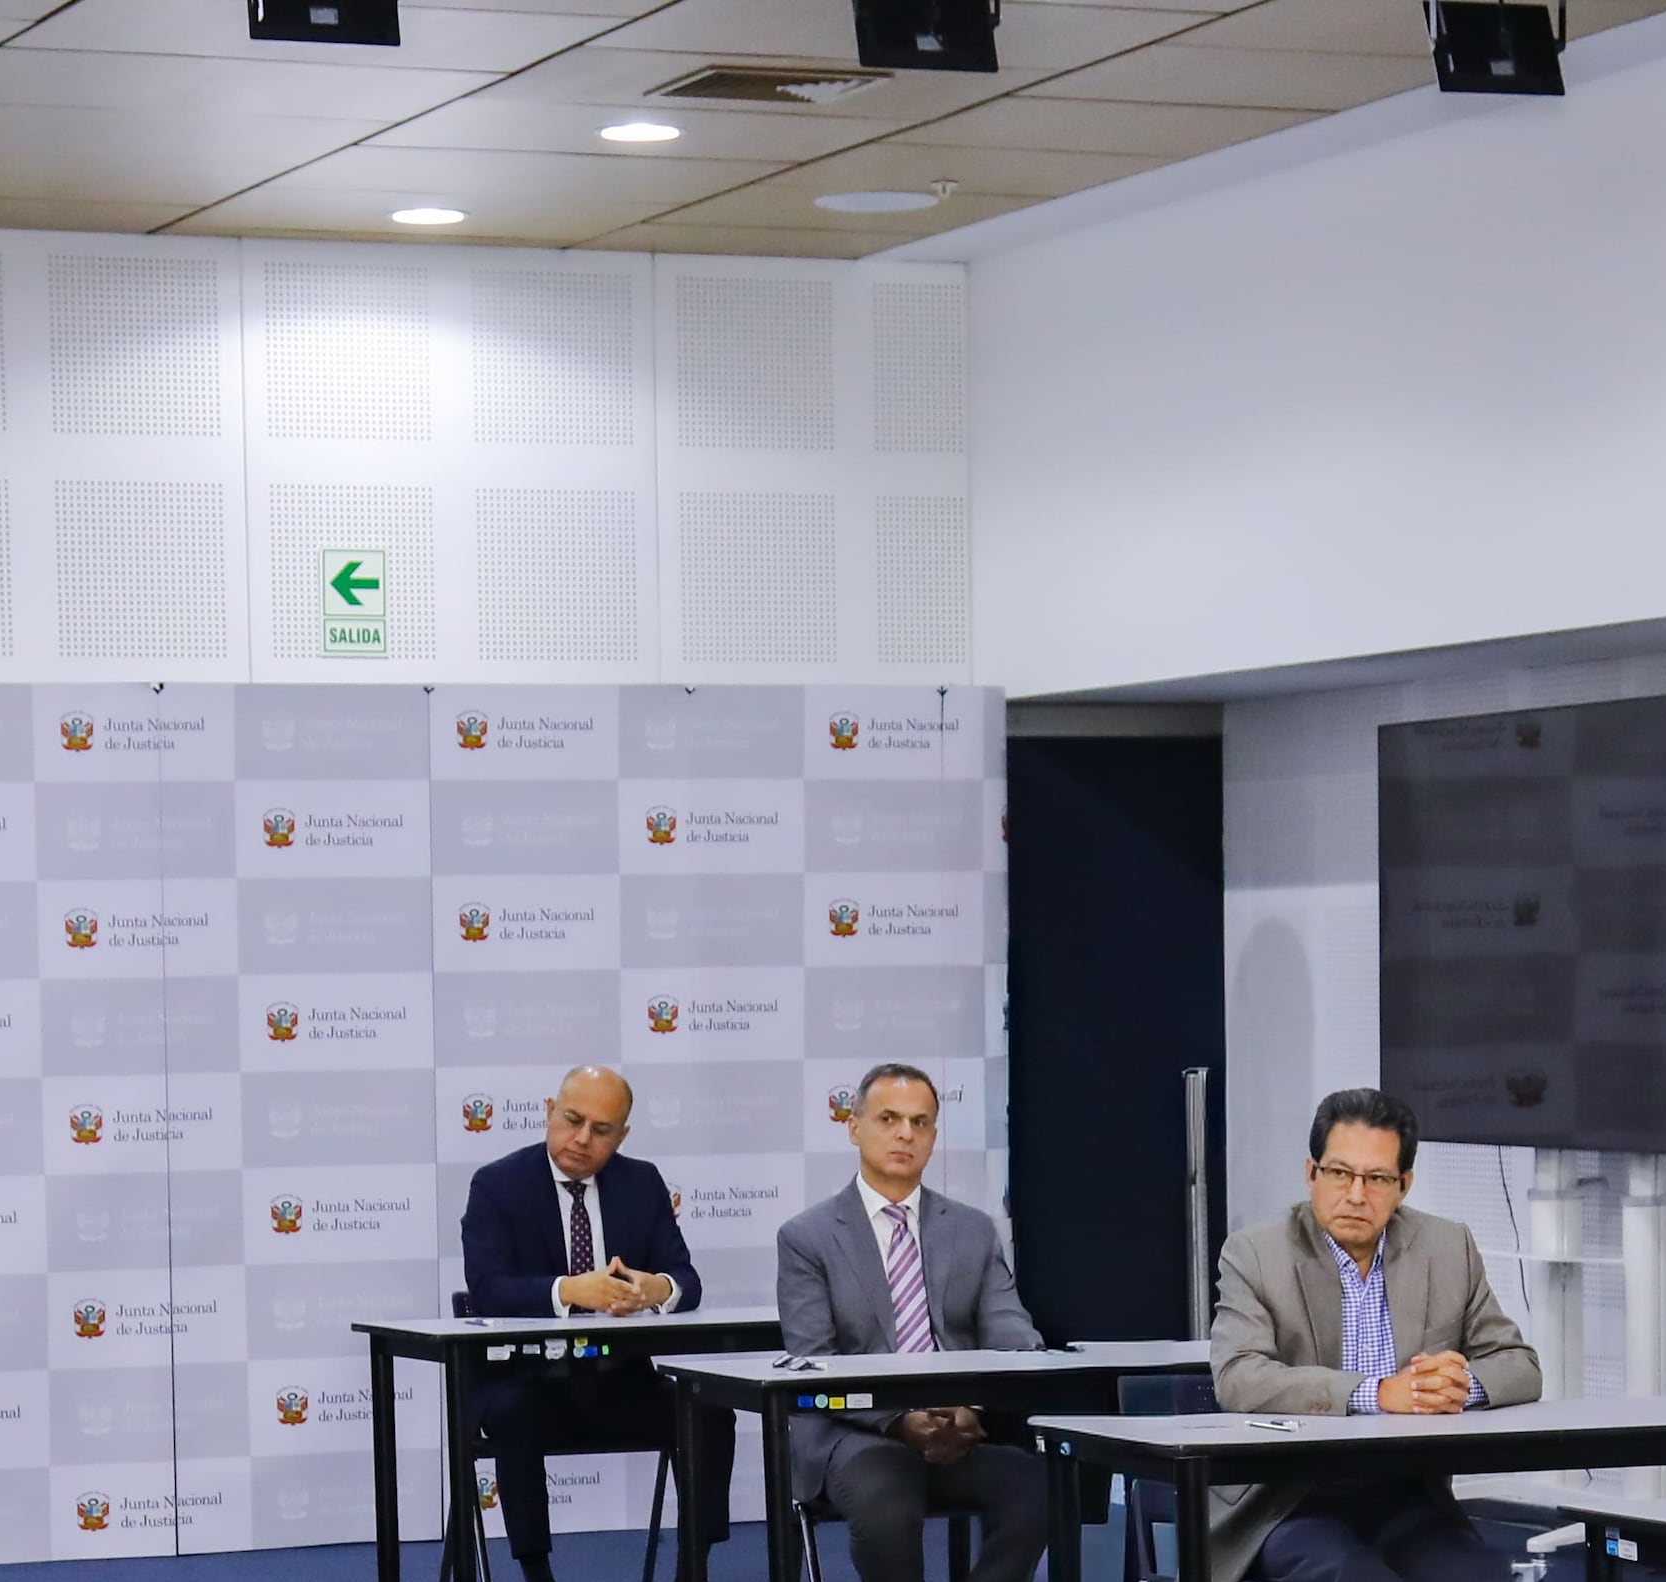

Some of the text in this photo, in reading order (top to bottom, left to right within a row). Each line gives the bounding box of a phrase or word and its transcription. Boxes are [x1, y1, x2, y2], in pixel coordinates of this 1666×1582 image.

[329, 627, 381, 644] SALIDA
[102, 716, 206, 733] Junta Nacional
[496, 716, 594, 732] Junta Nacional
[866, 717, 960, 732] Junta Nacional
[104, 735, 175, 751] de Justicia
[496, 734, 565, 750] de Justicia
[867, 735, 931, 750] de Justicia
[303, 813, 404, 829] Junta Nacional
[685, 810, 779, 826] Junta Nacional
[304, 831, 374, 847] de Justicia
[685, 828, 750, 844] de Justicia
[498, 907, 595, 923] Junta Nacional
[867, 903, 959, 919] Junta Nacional
[107, 911, 209, 929] Junta Nacional
[498, 925, 566, 941] de Justicia
[867, 921, 932, 936] de Justicia
[108, 931, 180, 948] de Justicia
[307, 1005, 407, 1023] Junta Nacional
[687, 999, 779, 1015] Junta Nacional
[308, 1024, 377, 1041] de Justicia
[687, 1017, 750, 1032] de Justicia
[502, 1099, 540, 1113] Junta
[111, 1106, 213, 1126] Junta Nacional
[502, 1116, 548, 1130] de Just
[112, 1126, 184, 1143] de Justicia
[689, 1184, 779, 1202] Junta Nacional
[311, 1196, 411, 1214] Junta Nacional
[690, 1204, 752, 1220] de Justicia
[312, 1216, 381, 1233] de Justicia
[114, 1299, 218, 1319] Junta Nacional
[116, 1319, 189, 1337] de Justicia
[317, 1391, 355, 1405] Junta
[318, 1407, 373, 1422] de Justic
[547, 1471, 601, 1487] Nacional
[118, 1491, 223, 1511] Junta Nacional
[548, 1490, 573, 1505] icia
[119, 1511, 194, 1529] de Justicia
